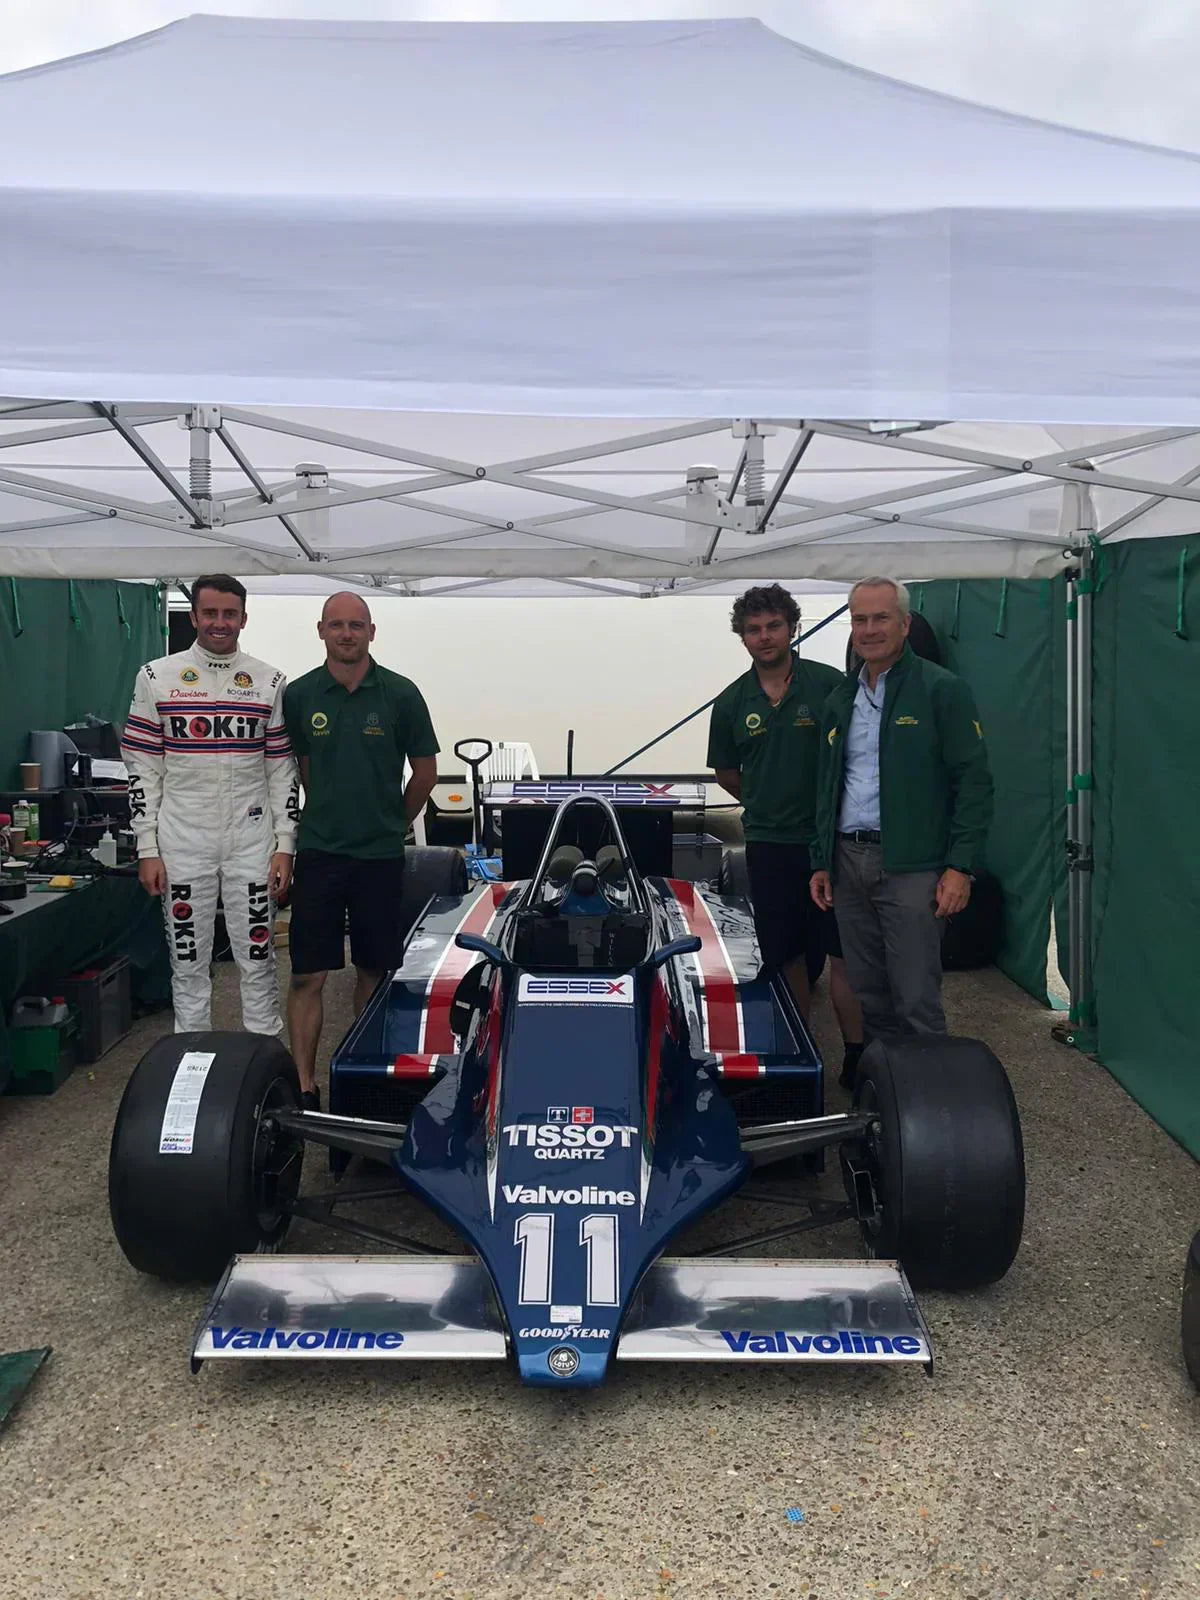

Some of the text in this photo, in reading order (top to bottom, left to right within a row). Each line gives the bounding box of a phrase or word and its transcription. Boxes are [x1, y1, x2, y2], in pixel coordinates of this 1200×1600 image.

[169, 689, 208, 698] Davison
[512, 782, 675, 798] ESSEX
[527, 981, 626, 995] ESSEX
[503, 1124, 638, 1147] TISSOT
[534, 1148, 605, 1160] QUARTZ
[502, 1185, 636, 1206] Valvoline
[514, 1213, 620, 1307] 11
[211, 1326, 405, 1350] Valvoline
[720, 1331, 921, 1354] Valvoline
[554, 1360, 575, 1368] LOTUS
